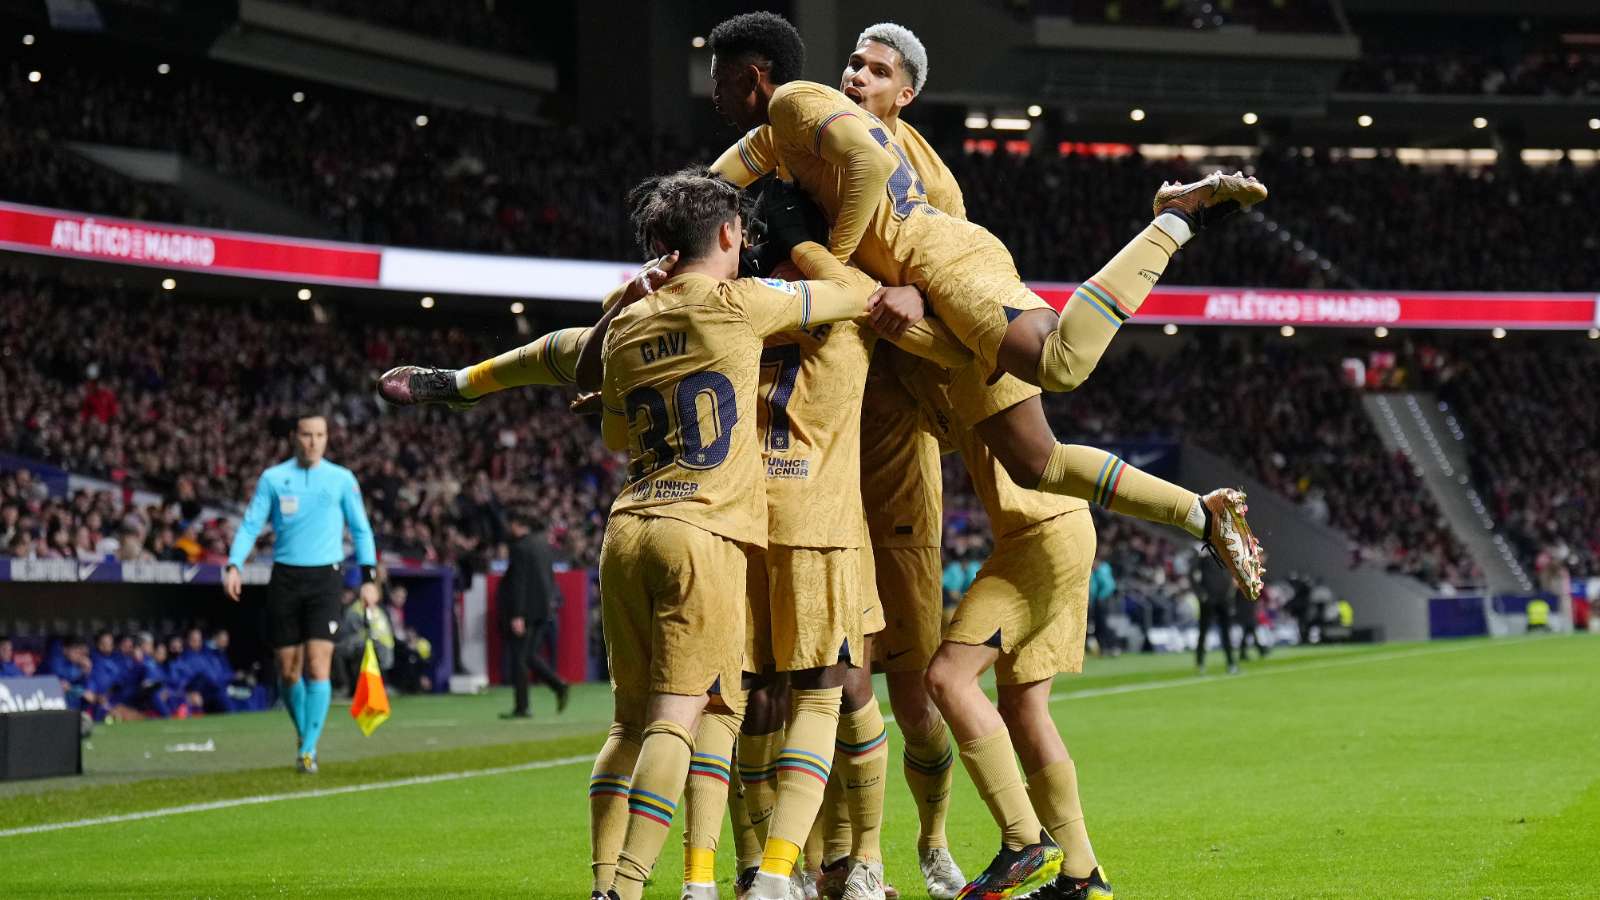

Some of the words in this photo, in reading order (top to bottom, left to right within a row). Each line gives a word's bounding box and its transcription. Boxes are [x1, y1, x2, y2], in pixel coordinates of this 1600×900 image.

[51, 218, 131, 257] ATLÉTICO
[143, 231, 215, 266] MADRID
[1205, 291, 1301, 321] ATLÉTICO
[1318, 295, 1401, 323] MADRID
[640, 331, 688, 364] GAVI
[758, 343, 802, 453] 7
[624, 371, 738, 483] 30
[767, 457, 809, 468] UNHCR
[767, 466, 809, 477] ACNUR
[655, 480, 699, 491] UNHCR
